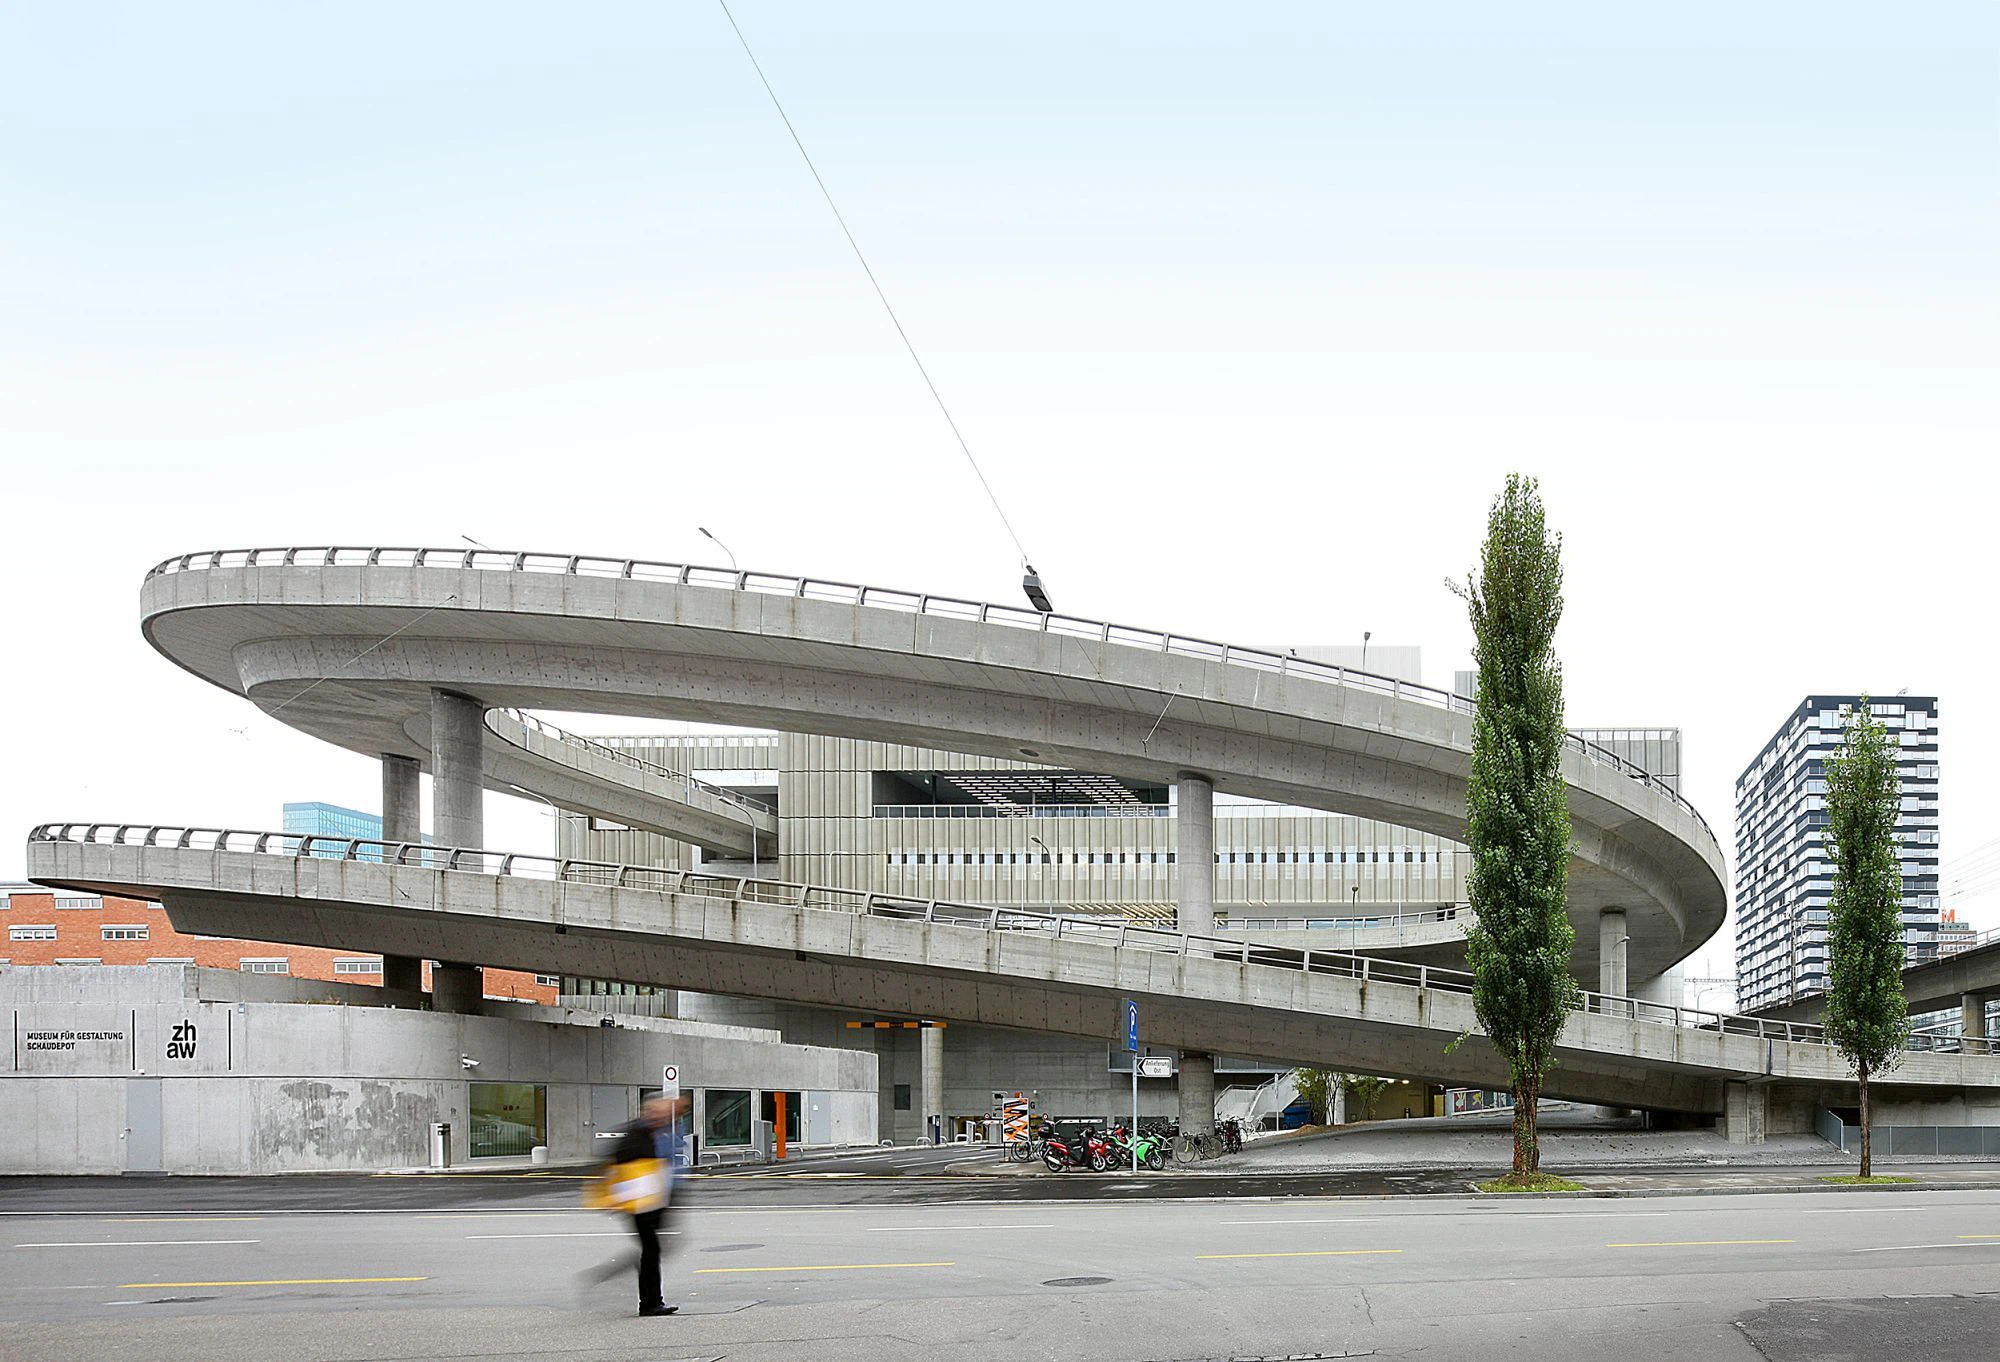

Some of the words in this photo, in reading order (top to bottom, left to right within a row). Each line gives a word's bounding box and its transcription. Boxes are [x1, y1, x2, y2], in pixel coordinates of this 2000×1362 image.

[1131, 1011, 1135, 1031] P
[27, 1032, 59, 1040] MUSEUM
[60, 1030, 75, 1040] FÜR
[76, 1032, 123, 1040] GESTALTUNG
[172, 1019, 196, 1041] zh
[27, 1042, 75, 1050] SCHAUDEPOT
[166, 1042, 196, 1059] aw
